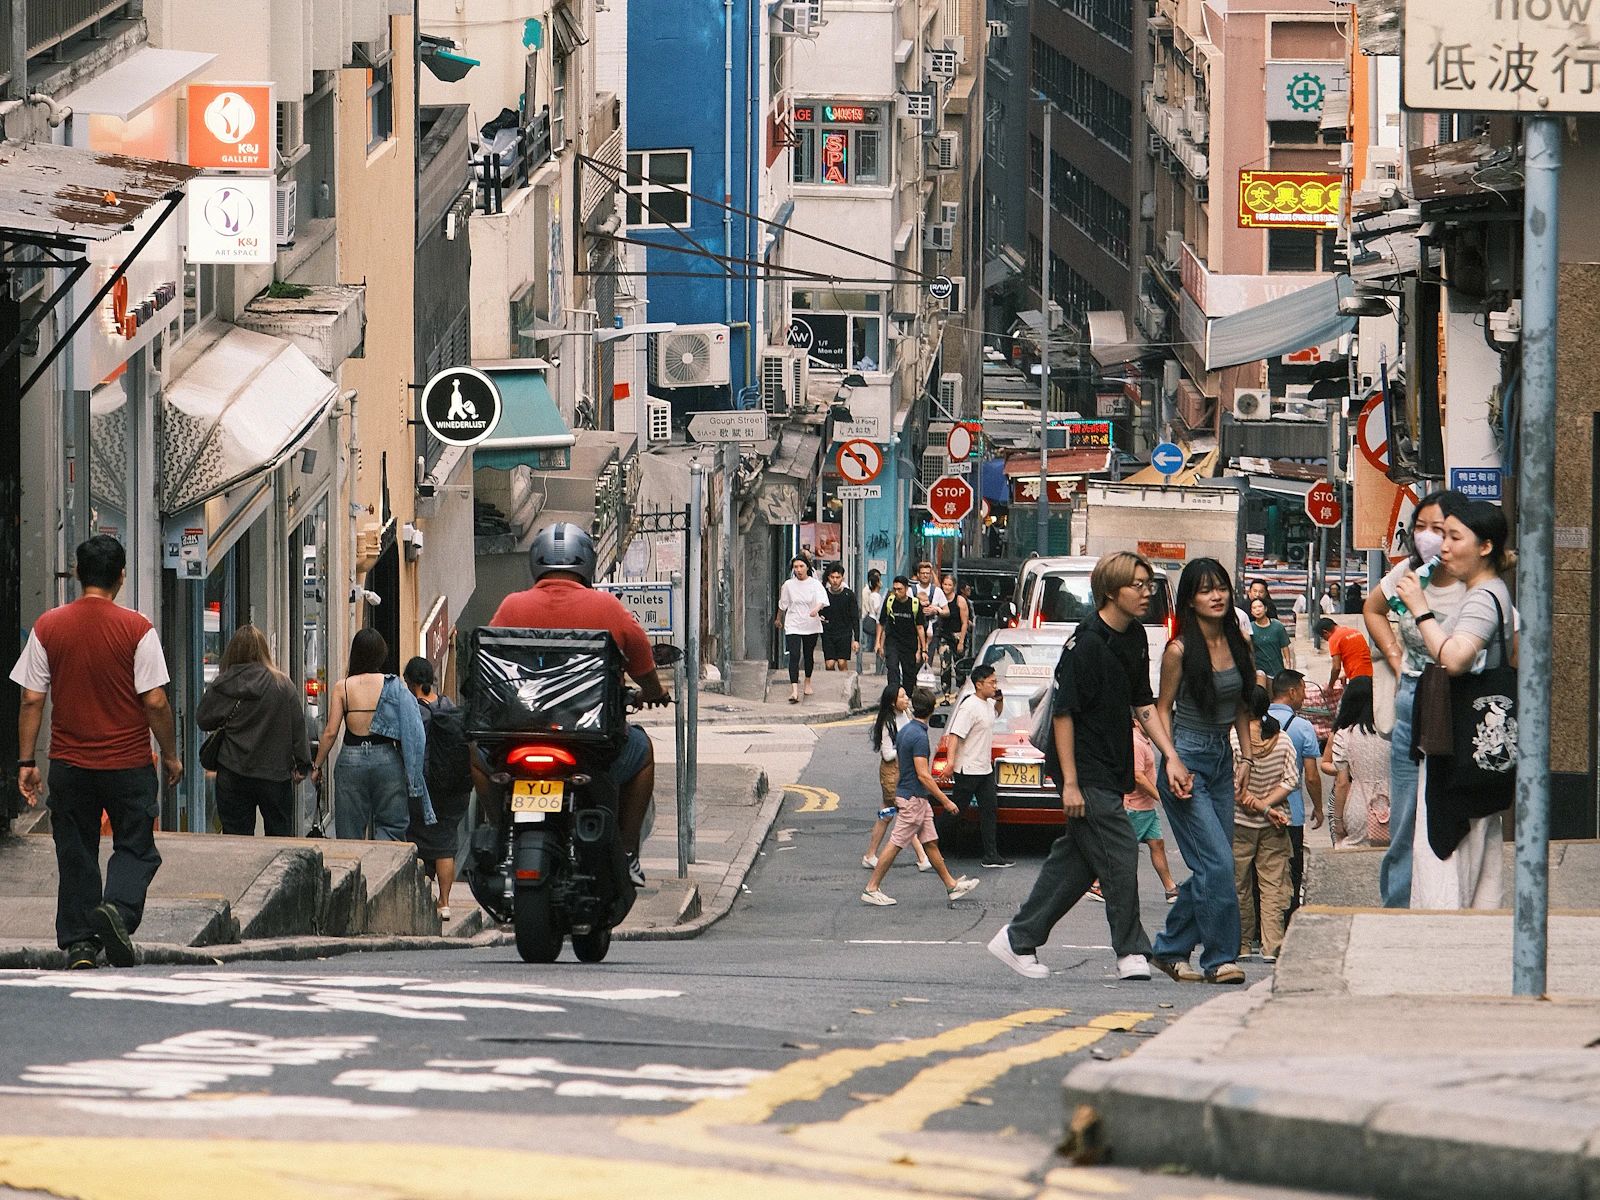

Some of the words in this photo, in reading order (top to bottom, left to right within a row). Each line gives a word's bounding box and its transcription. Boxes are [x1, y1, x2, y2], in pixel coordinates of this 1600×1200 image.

[1425, 41, 1600, 95] 低波行
[238, 143, 259, 154] K&J
[222, 155, 259, 163] GALLERY
[825, 135, 846, 184] SPA
[238, 238, 258, 247] K&J
[435, 420, 487, 429] WINEDERLUST
[709, 417, 736, 425] Gough
[737, 416, 763, 424] Street
[863, 488, 878, 497] 7m
[936, 487, 966, 497] STOP
[943, 502, 957, 515] 停
[1320, 506, 1332, 520] 停
[626, 594, 664, 605] Toilets
[1010, 666, 1051, 676] TAXI
[1012, 764, 1028, 774] VD
[1003, 774, 1036, 784] 7784
[514, 796, 560, 809] 8706
